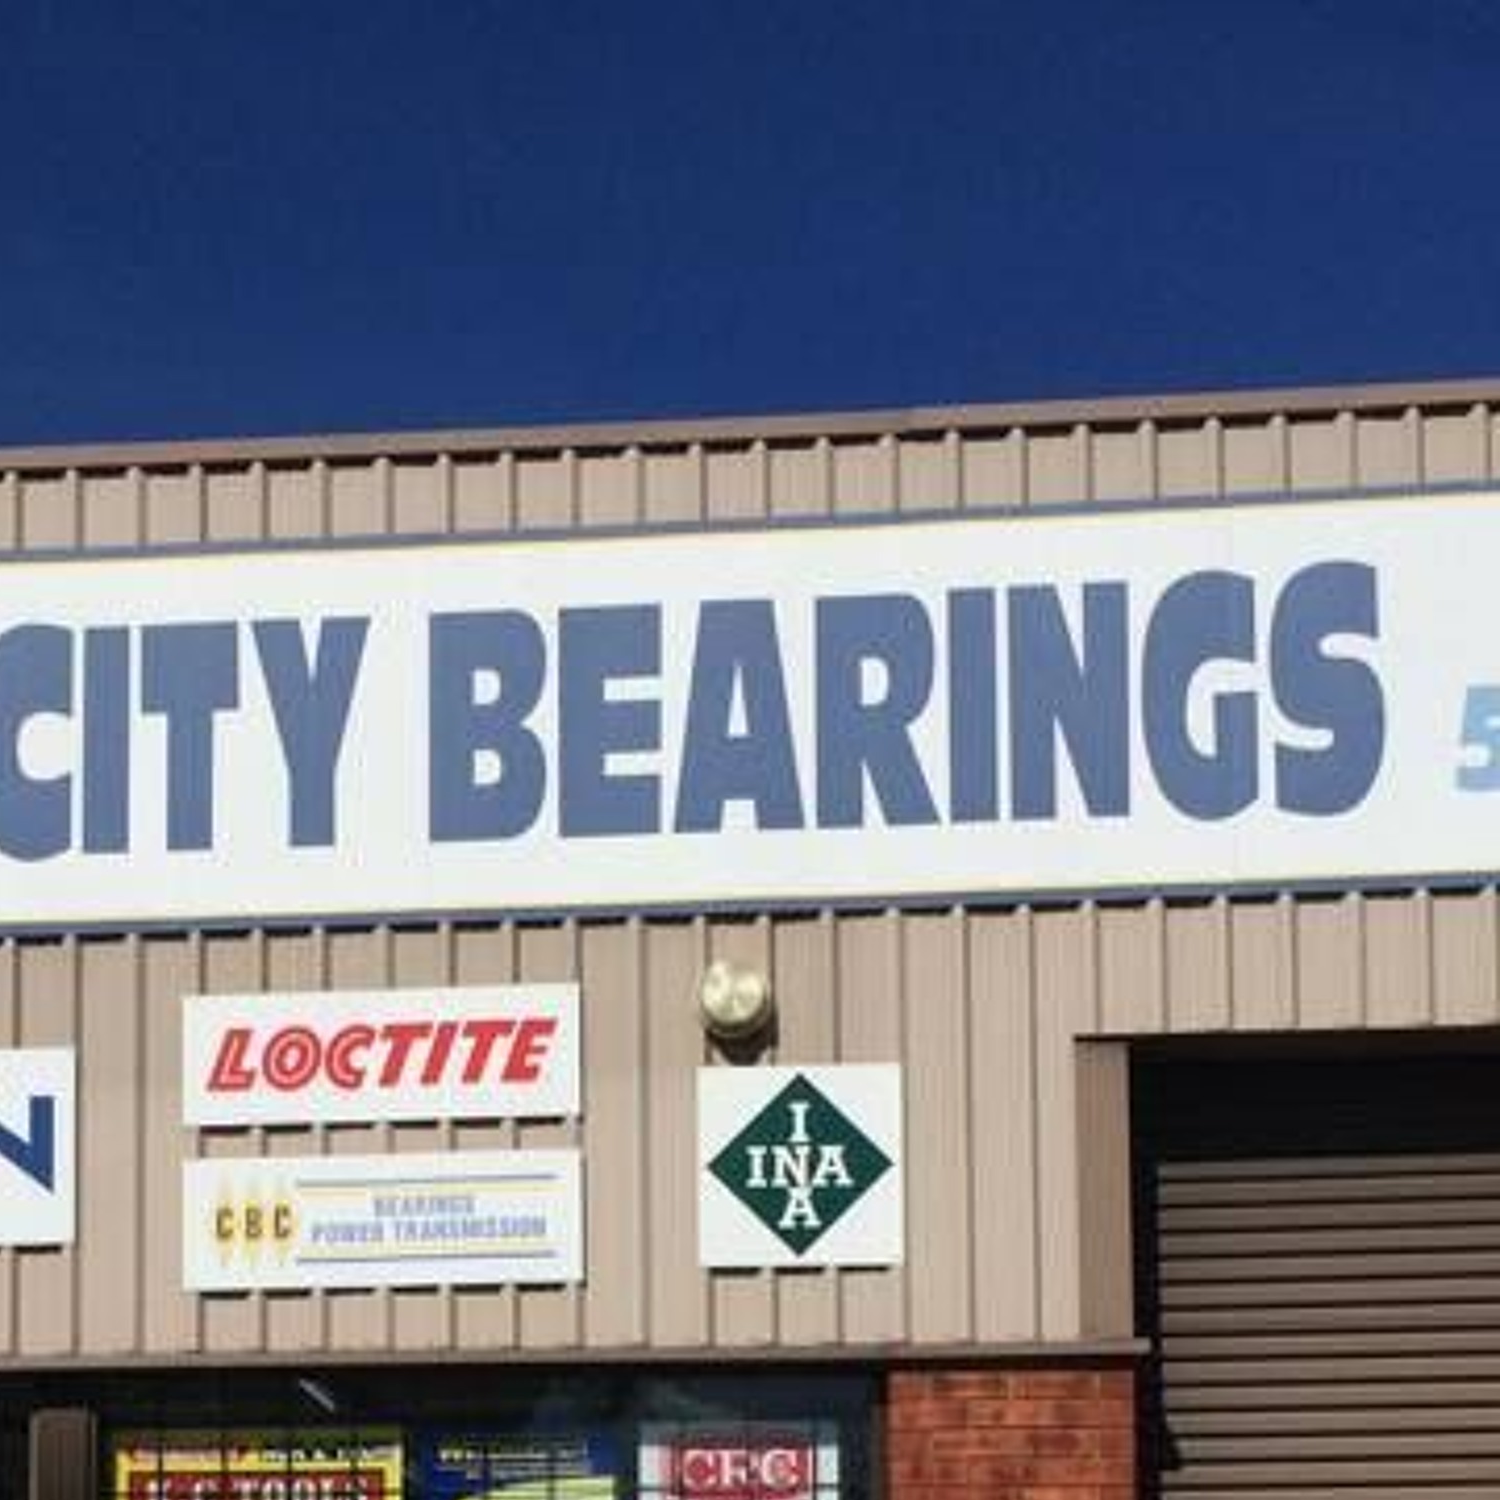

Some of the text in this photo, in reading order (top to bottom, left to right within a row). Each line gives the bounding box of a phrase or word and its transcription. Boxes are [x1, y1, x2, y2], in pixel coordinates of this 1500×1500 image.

[428, 560, 1387, 844] BEARINGS
[206, 1018, 559, 1093] LOCTITE
[744, 1144, 855, 1189] INA
[373, 1193, 476, 1217] BEARINGS
[310, 1215, 547, 1244] POWER TRANSMISSION
[682, 1447, 800, 1490] CRC
